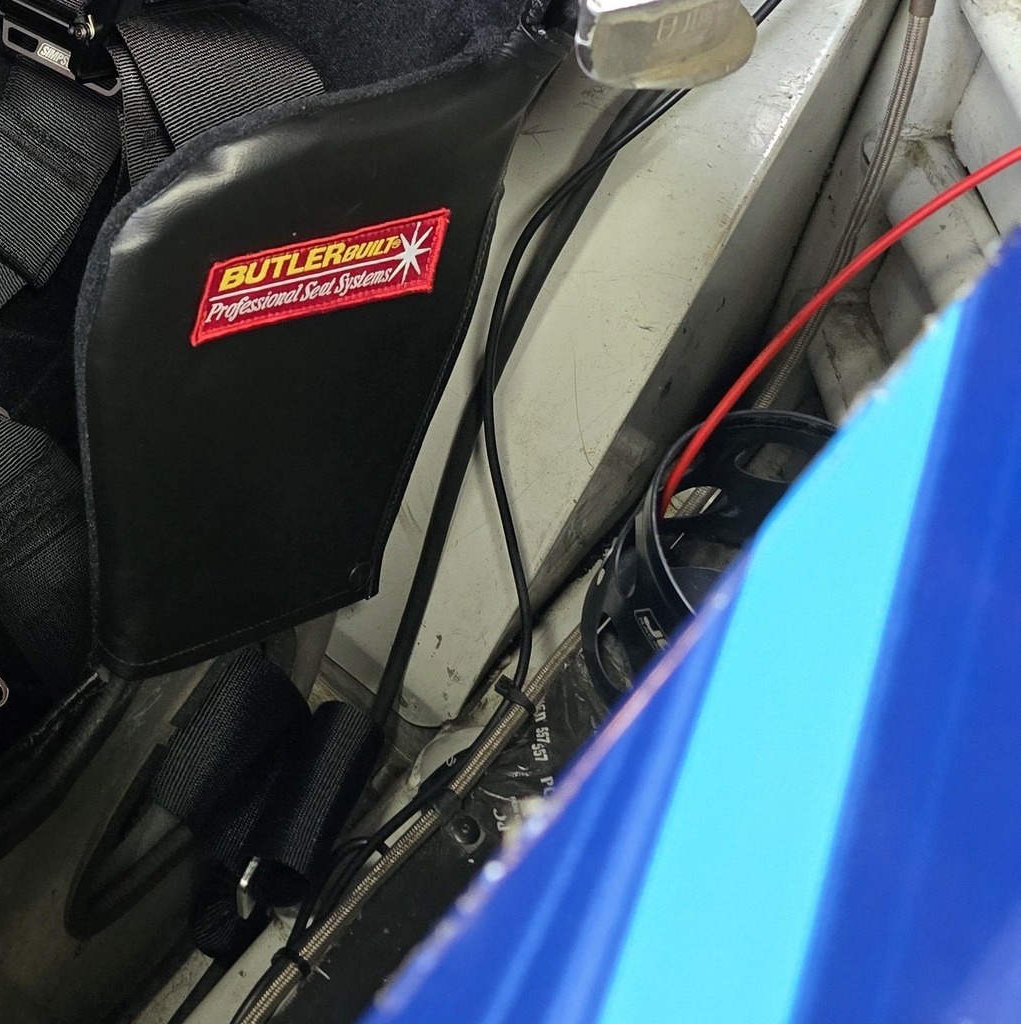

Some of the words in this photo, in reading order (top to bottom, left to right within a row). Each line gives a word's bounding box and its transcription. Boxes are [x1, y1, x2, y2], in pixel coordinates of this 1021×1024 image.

[40, 45, 71, 68] SIMPS
[218, 235, 399, 292] BUTLERBUILT
[204, 284, 301, 323] Professional
[300, 277, 334, 303] Seat
[334, 268, 393, 297] Systems
